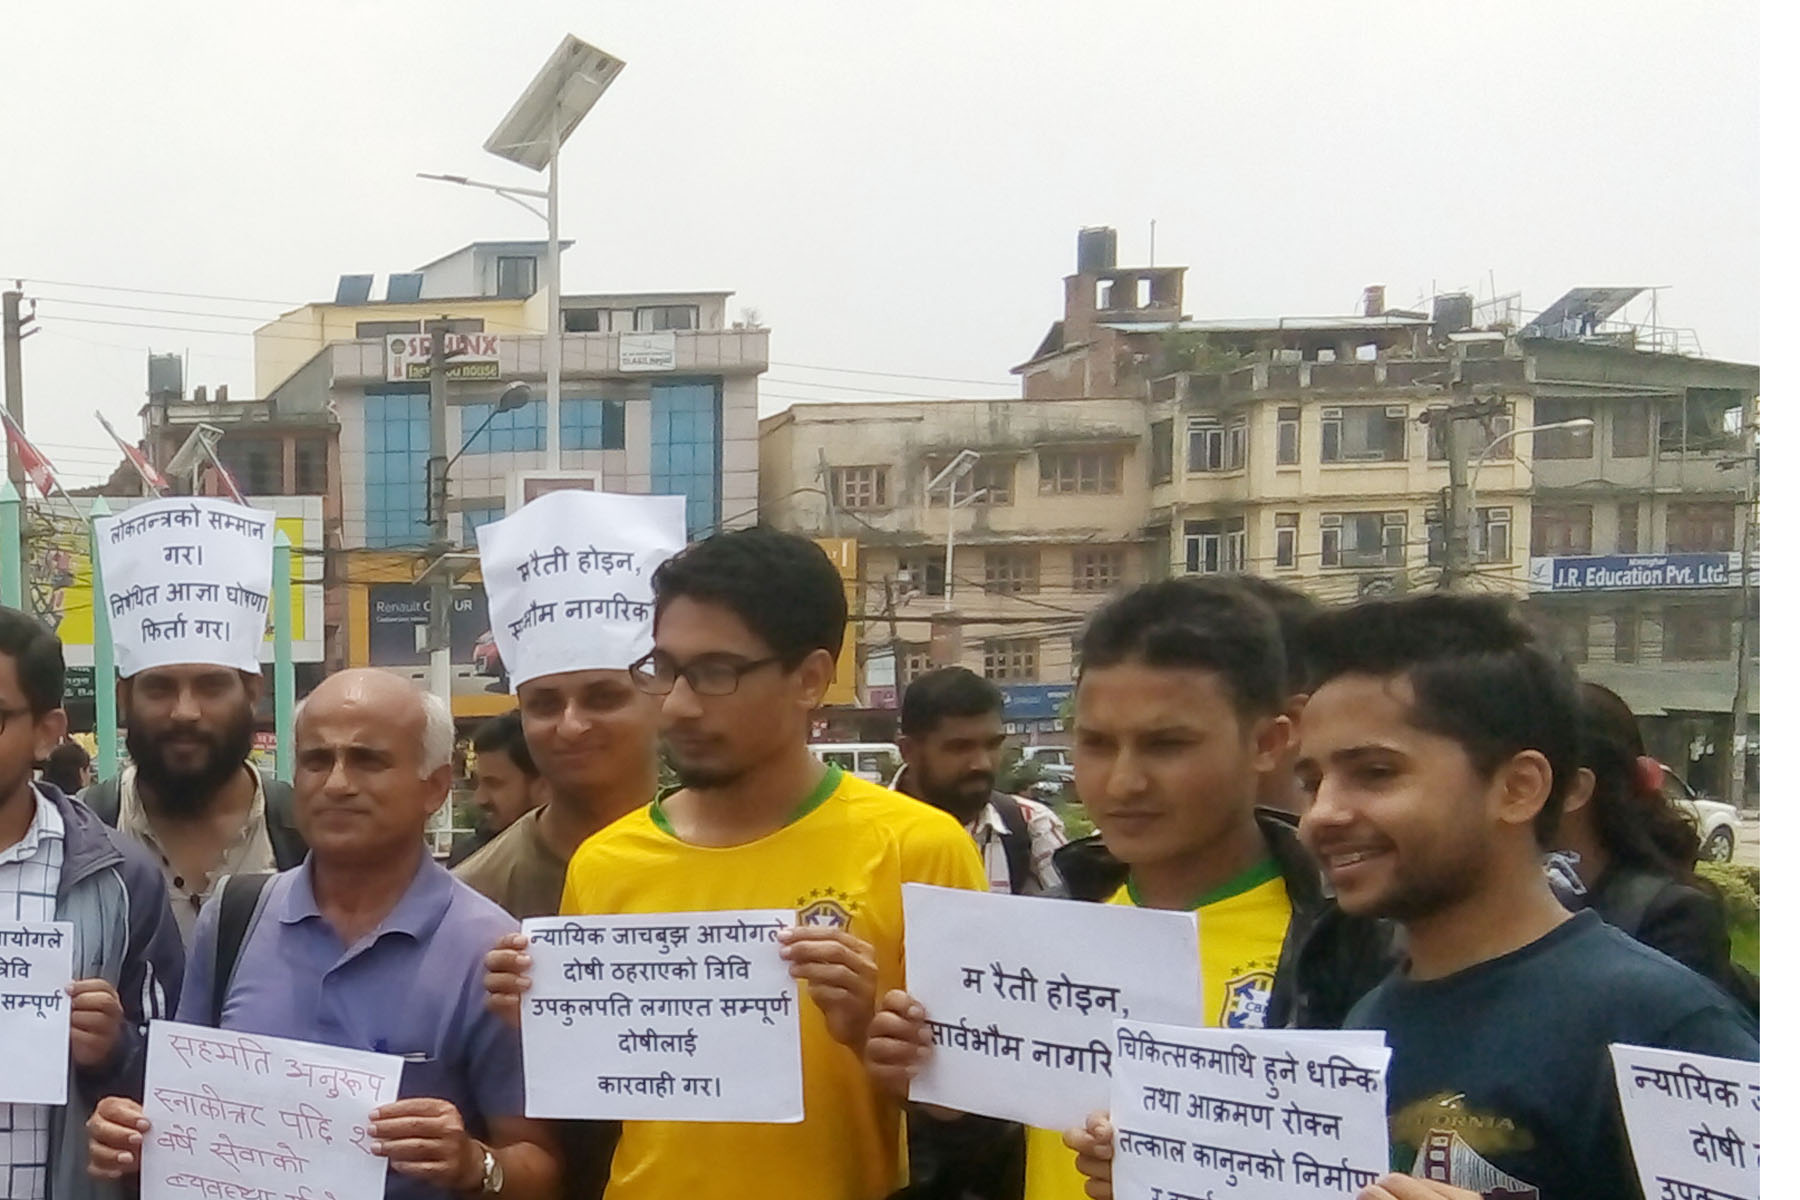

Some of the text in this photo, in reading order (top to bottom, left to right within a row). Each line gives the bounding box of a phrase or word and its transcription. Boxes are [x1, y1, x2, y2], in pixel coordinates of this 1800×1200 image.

[110, 504, 266, 544] लोकतन्त्रको सम्मान
[164, 545, 202, 566] गर।
[577, 544, 640, 576] होइन,
[1555, 567, 1581, 588] J.R.
[1586, 564, 1662, 587] Education
[1666, 564, 1694, 585] Pvt.
[1699, 563, 1728, 584] Ltd.
[166, 582, 220, 602] आज्ञा
[226, 582, 268, 614] घोषणा
[376, 600, 420, 613] Renault
[142, 612, 188, 643] फिर्ता
[195, 619, 230, 642] गर।
[530, 922, 606, 946] न्यायिक
[612, 926, 691, 954] जाचबुझ
[563, 956, 752, 984] दोषी ठहराएको त्रिवि
[1, 990, 64, 1020] सम्पूर्ण
[961, 961, 1130, 1019] म रैती होइन,
[531, 990, 792, 1026] उपकुलपति लगाएत सम्पूर्ण
[168, 1034, 272, 1075] सहमति
[618, 1028, 698, 1058] दोषीलाई
[1032, 1038, 1112, 1079] नागरि
[1117, 1026, 1257, 1080] चिकित्सकमाथि
[1262, 1050, 1300, 1099] हुने
[598, 1070, 722, 1098] कारवाही गर।
[1631, 1064, 1740, 1109] न्यायिक
[1143, 1085, 1343, 1142] तथा आक्रमण रोक्न
[1119, 1128, 1186, 1163] तत्काल
[1192, 1148, 1285, 1188] कानुनको
[1689, 1122, 1746, 1170] दोषी
